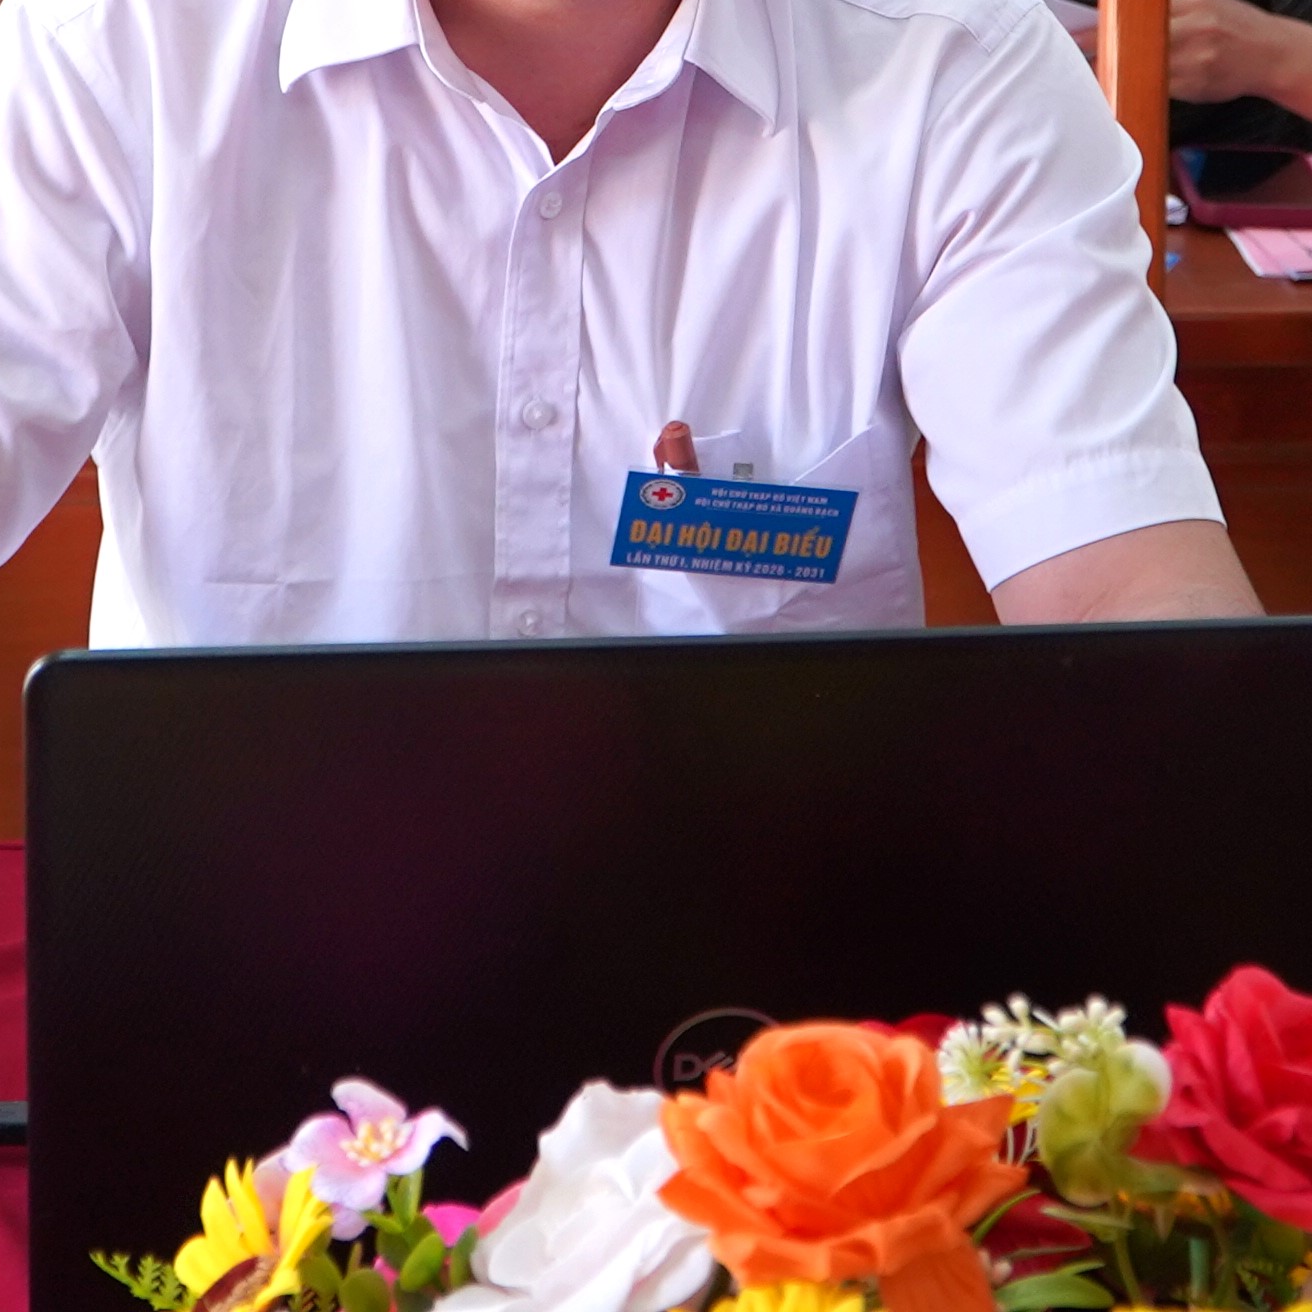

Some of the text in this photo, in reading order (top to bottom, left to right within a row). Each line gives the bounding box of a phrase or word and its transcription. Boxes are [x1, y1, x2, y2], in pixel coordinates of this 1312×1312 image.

[629, 519, 674, 549] ĐẠI
[677, 521, 722, 554] HỘI
[725, 528, 770, 558] ĐẠI
[691, 557, 733, 572] NHIỆM
[794, 566, 826, 579] 2031
